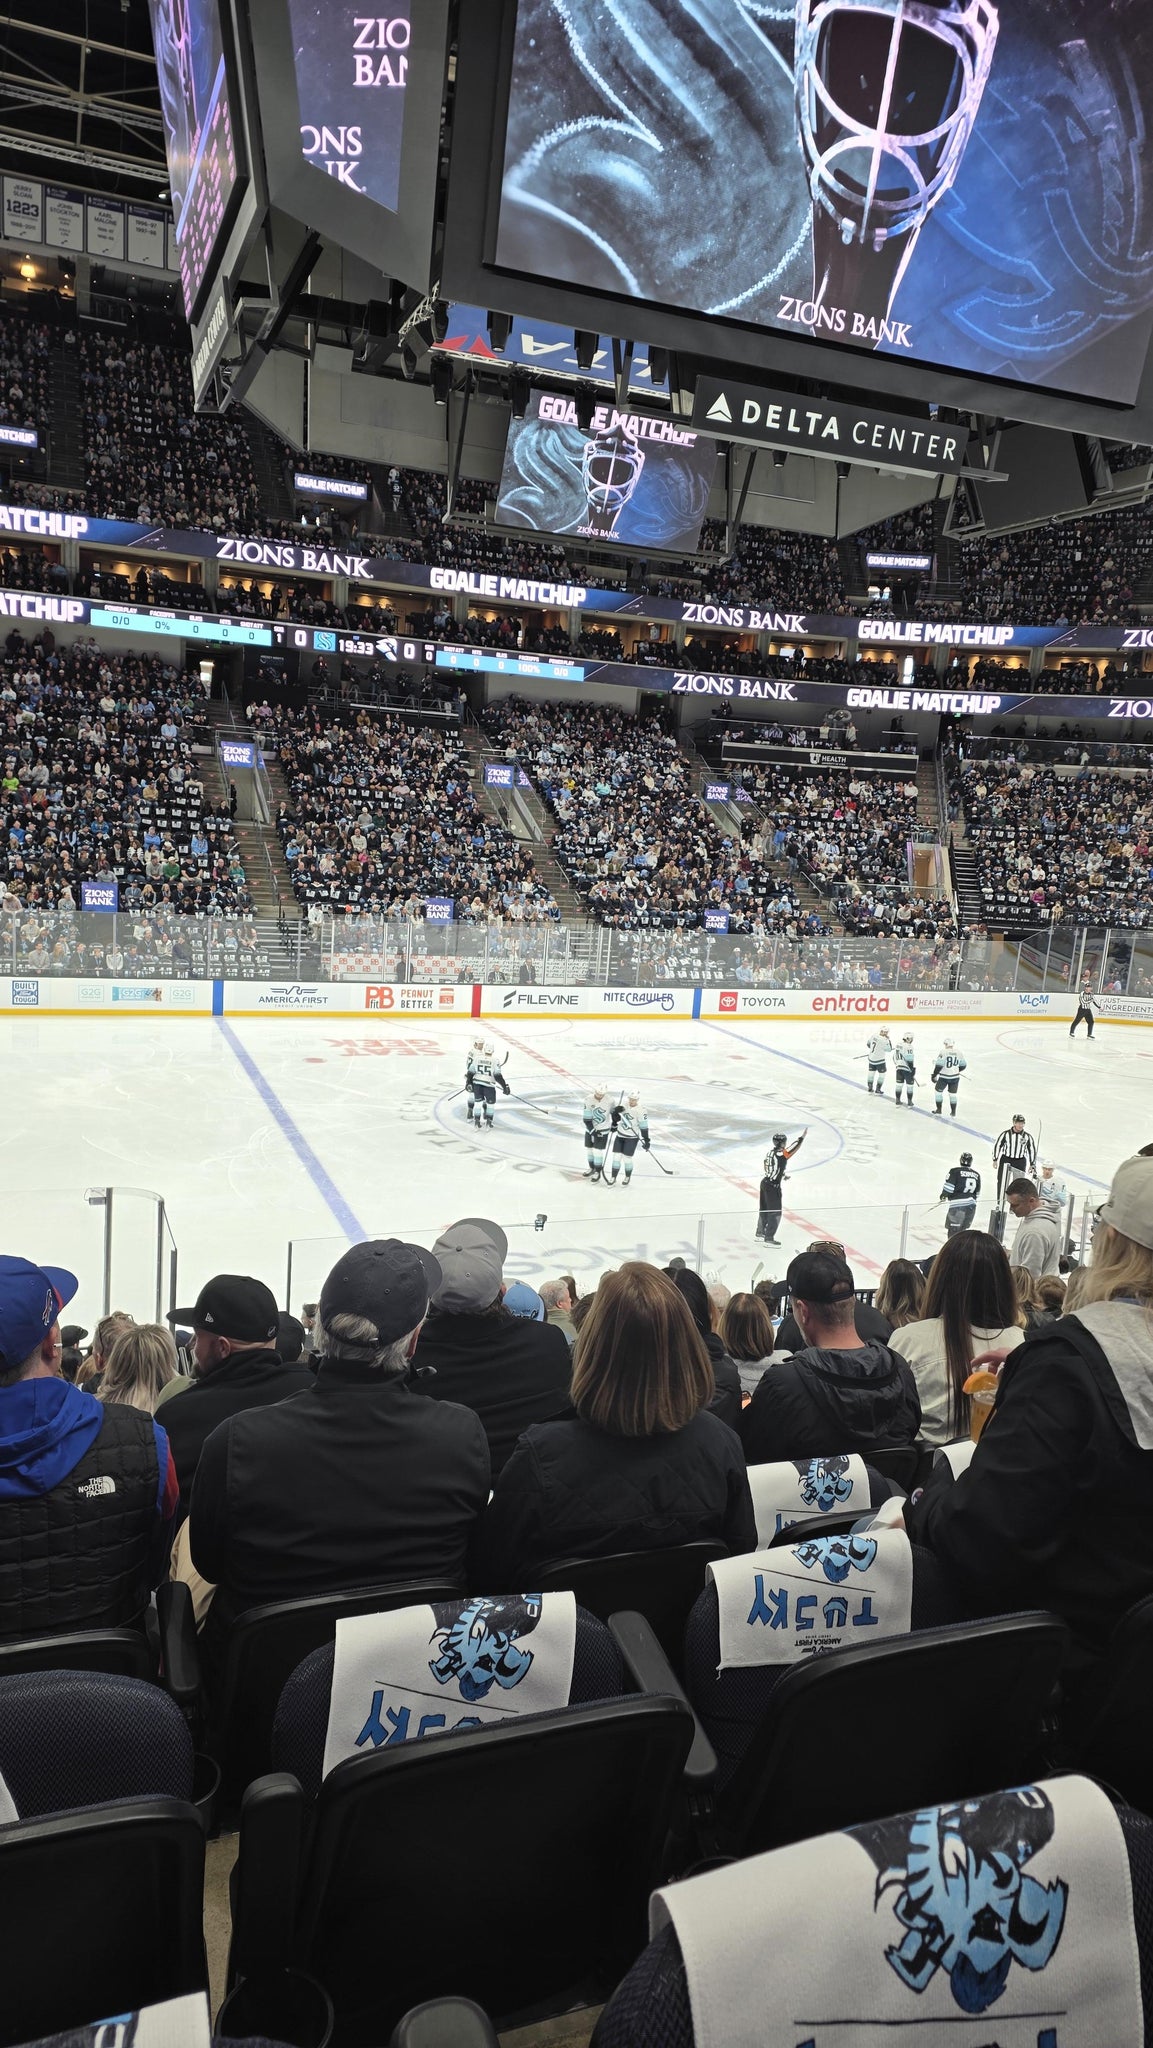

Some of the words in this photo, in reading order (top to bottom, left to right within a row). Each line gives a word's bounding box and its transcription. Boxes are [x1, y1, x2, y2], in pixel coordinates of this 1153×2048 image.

[352, 17, 411, 49] ZIO
[352, 54, 408, 86] BA
[300, 125, 363, 156] ONS
[13, 191, 33, 199] SLOAN
[7, 199, 40, 217] 1223
[50, 207, 80, 218] STOCKTON
[99, 211, 113, 220] KARL
[94, 217, 118, 227] MALONE
[777, 295, 846, 332] ZIONS
[851, 313, 912, 347] BANK
[0, 428, 35, 443] ATCHUP
[742, 400, 839, 440] DELTA
[853, 422, 957, 461] CENTER
[297, 477, 326, 490] GOALIE
[327, 482, 365, 496] MATCHUP
[0, 505, 88, 539] ATCHUP
[577, 525, 599, 536] ZIONS
[600, 529, 620, 539] BANK
[216, 537, 295, 568] ZIONS
[301, 549, 371, 579] BANK
[868, 555, 893, 566] GOALIE
[894, 557, 929, 568] MATCHUP
[430, 567, 499, 595] GOALIE
[500, 577, 587, 608] MATCHUP
[0, 592, 84, 623] ATCHUP
[112, 616, 130, 626] 0/0
[682, 602, 745, 627] ZIONS
[749, 610, 806, 633] BANK
[193, 625, 199, 633] 0
[223, 629, 228, 637] 0
[857, 620, 922, 641] GOALIE
[925, 625, 1014, 645] MATCHUP
[249, 632, 255, 640] 0
[277, 633, 282, 643] 1
[294, 630, 307, 646] 0
[339, 639, 374, 655] 19:33
[404, 643, 416, 659] 0
[426, 651, 433, 661] 0
[672, 672, 734, 696] ZIONS
[738, 680, 795, 701] BANK
[846, 688, 910, 710] GOALIE
[912, 692, 1001, 714] MATCHUP
[223, 746, 251, 755] ZIONS
[223, 753, 252, 763] BANK
[822, 755, 847, 763] HEALTH
[487, 768, 511, 777] ZIONS
[487, 775, 512, 784] BANK
[707, 785, 728, 794] ZIONS
[706, 792, 728, 800] BANK
[84, 889, 114, 898] ZIONS
[84, 897, 115, 906] BANK
[426, 904, 451, 912] ZIONS
[426, 911, 451, 919] BANK
[705, 921, 727, 929] BANK
[15, 982, 36, 990] BUILT
[81, 988, 101, 996] G2G
[122, 989, 142, 997] G2G
[172, 989, 192, 997] G2G
[400, 989, 434, 998] PEANUT
[302, 996, 328, 1004] FIRST
[370, 1000, 379, 1009] fit
[400, 1000, 433, 1009] BETTER
[518, 994, 579, 1005] FILEVINE
[742, 997, 786, 1007] TOYOTA
[812, 993, 890, 1012] entrata
[321, 1038, 440, 1048] GEEK
[339, 1047, 447, 1057] SEAT
[477, 1064, 492, 1077] 55
[89, 1476, 103, 1486] THE
[78, 1483, 103, 1493] NORTH
[86, 1489, 105, 1498] FACE
[747, 1574, 879, 1632] TUSKY
[794, 1639, 813, 1647] FIRST
[813, 1637, 842, 1646] AMERICA
